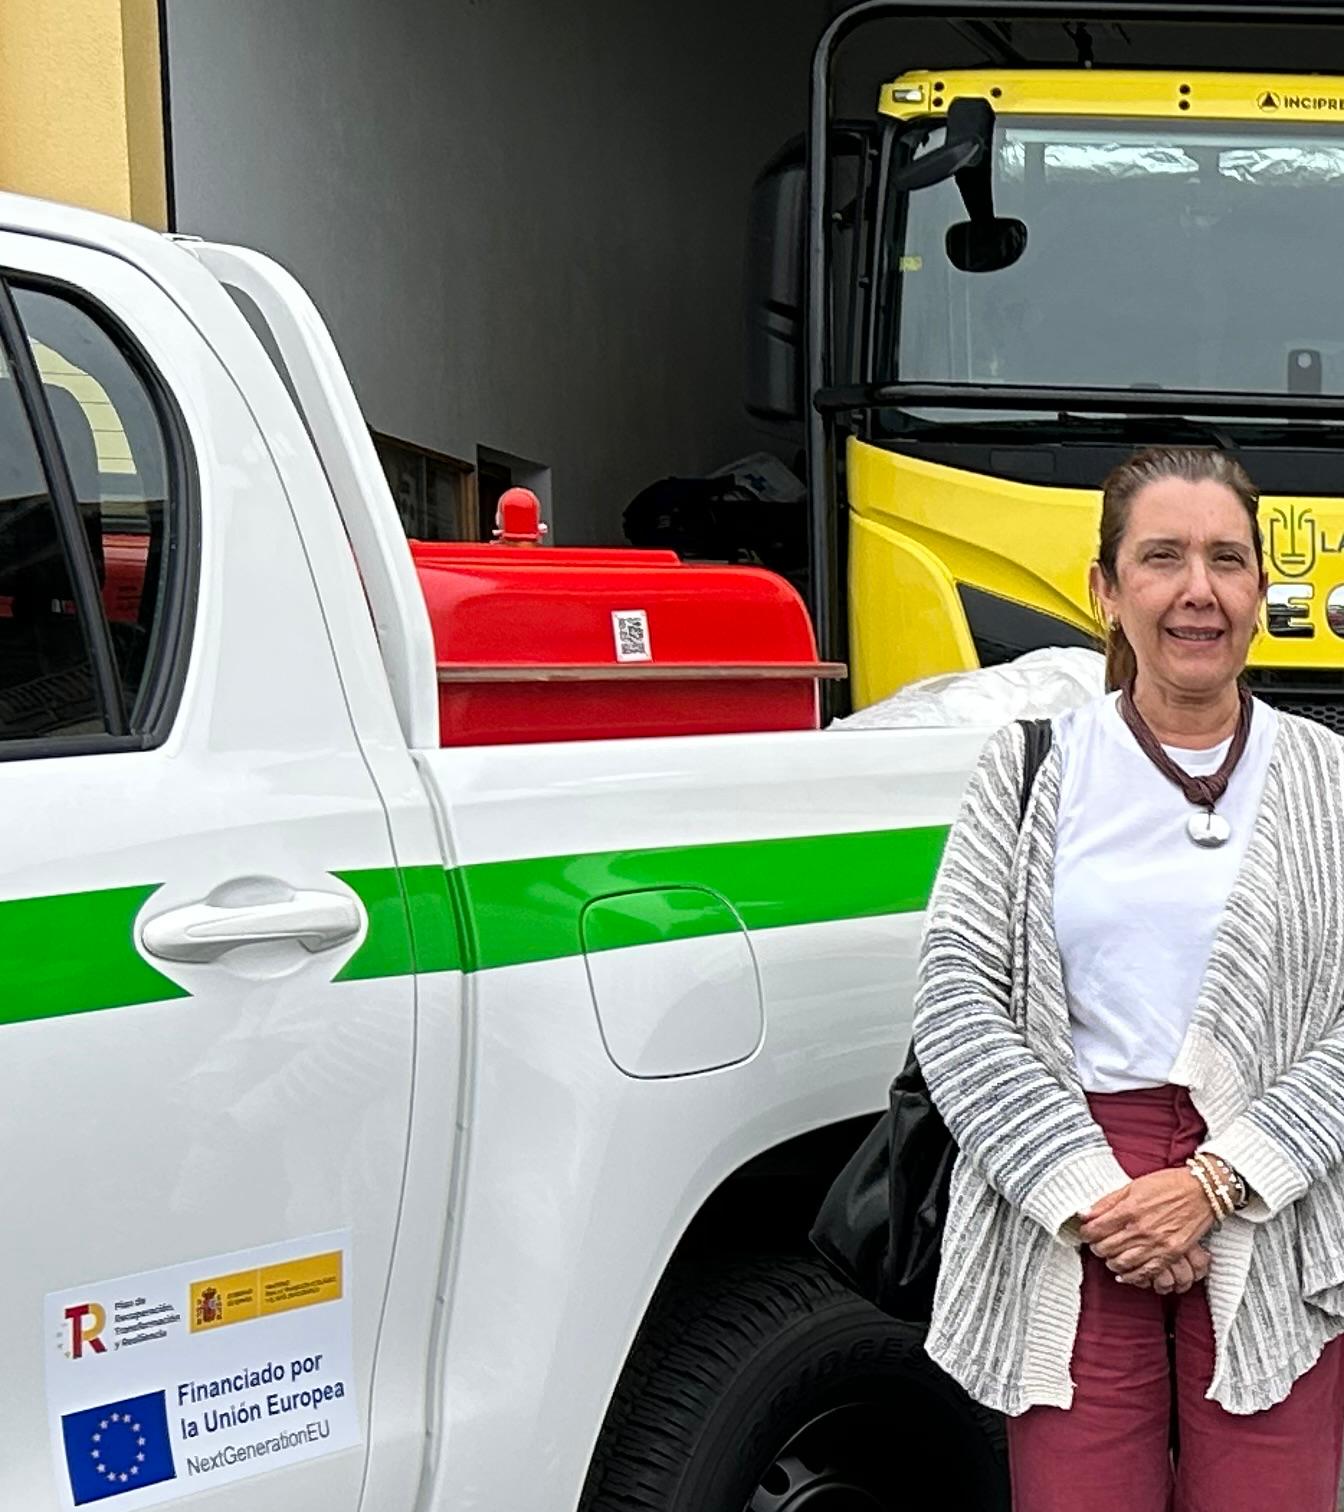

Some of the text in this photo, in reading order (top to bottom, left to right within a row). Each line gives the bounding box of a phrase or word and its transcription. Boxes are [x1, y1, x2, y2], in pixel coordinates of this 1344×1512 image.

[178, 1354, 323, 1405] Financiado por
[182, 1382, 345, 1439] la Unión Europea
[187, 1420, 330, 1476] NextGenerationEU
